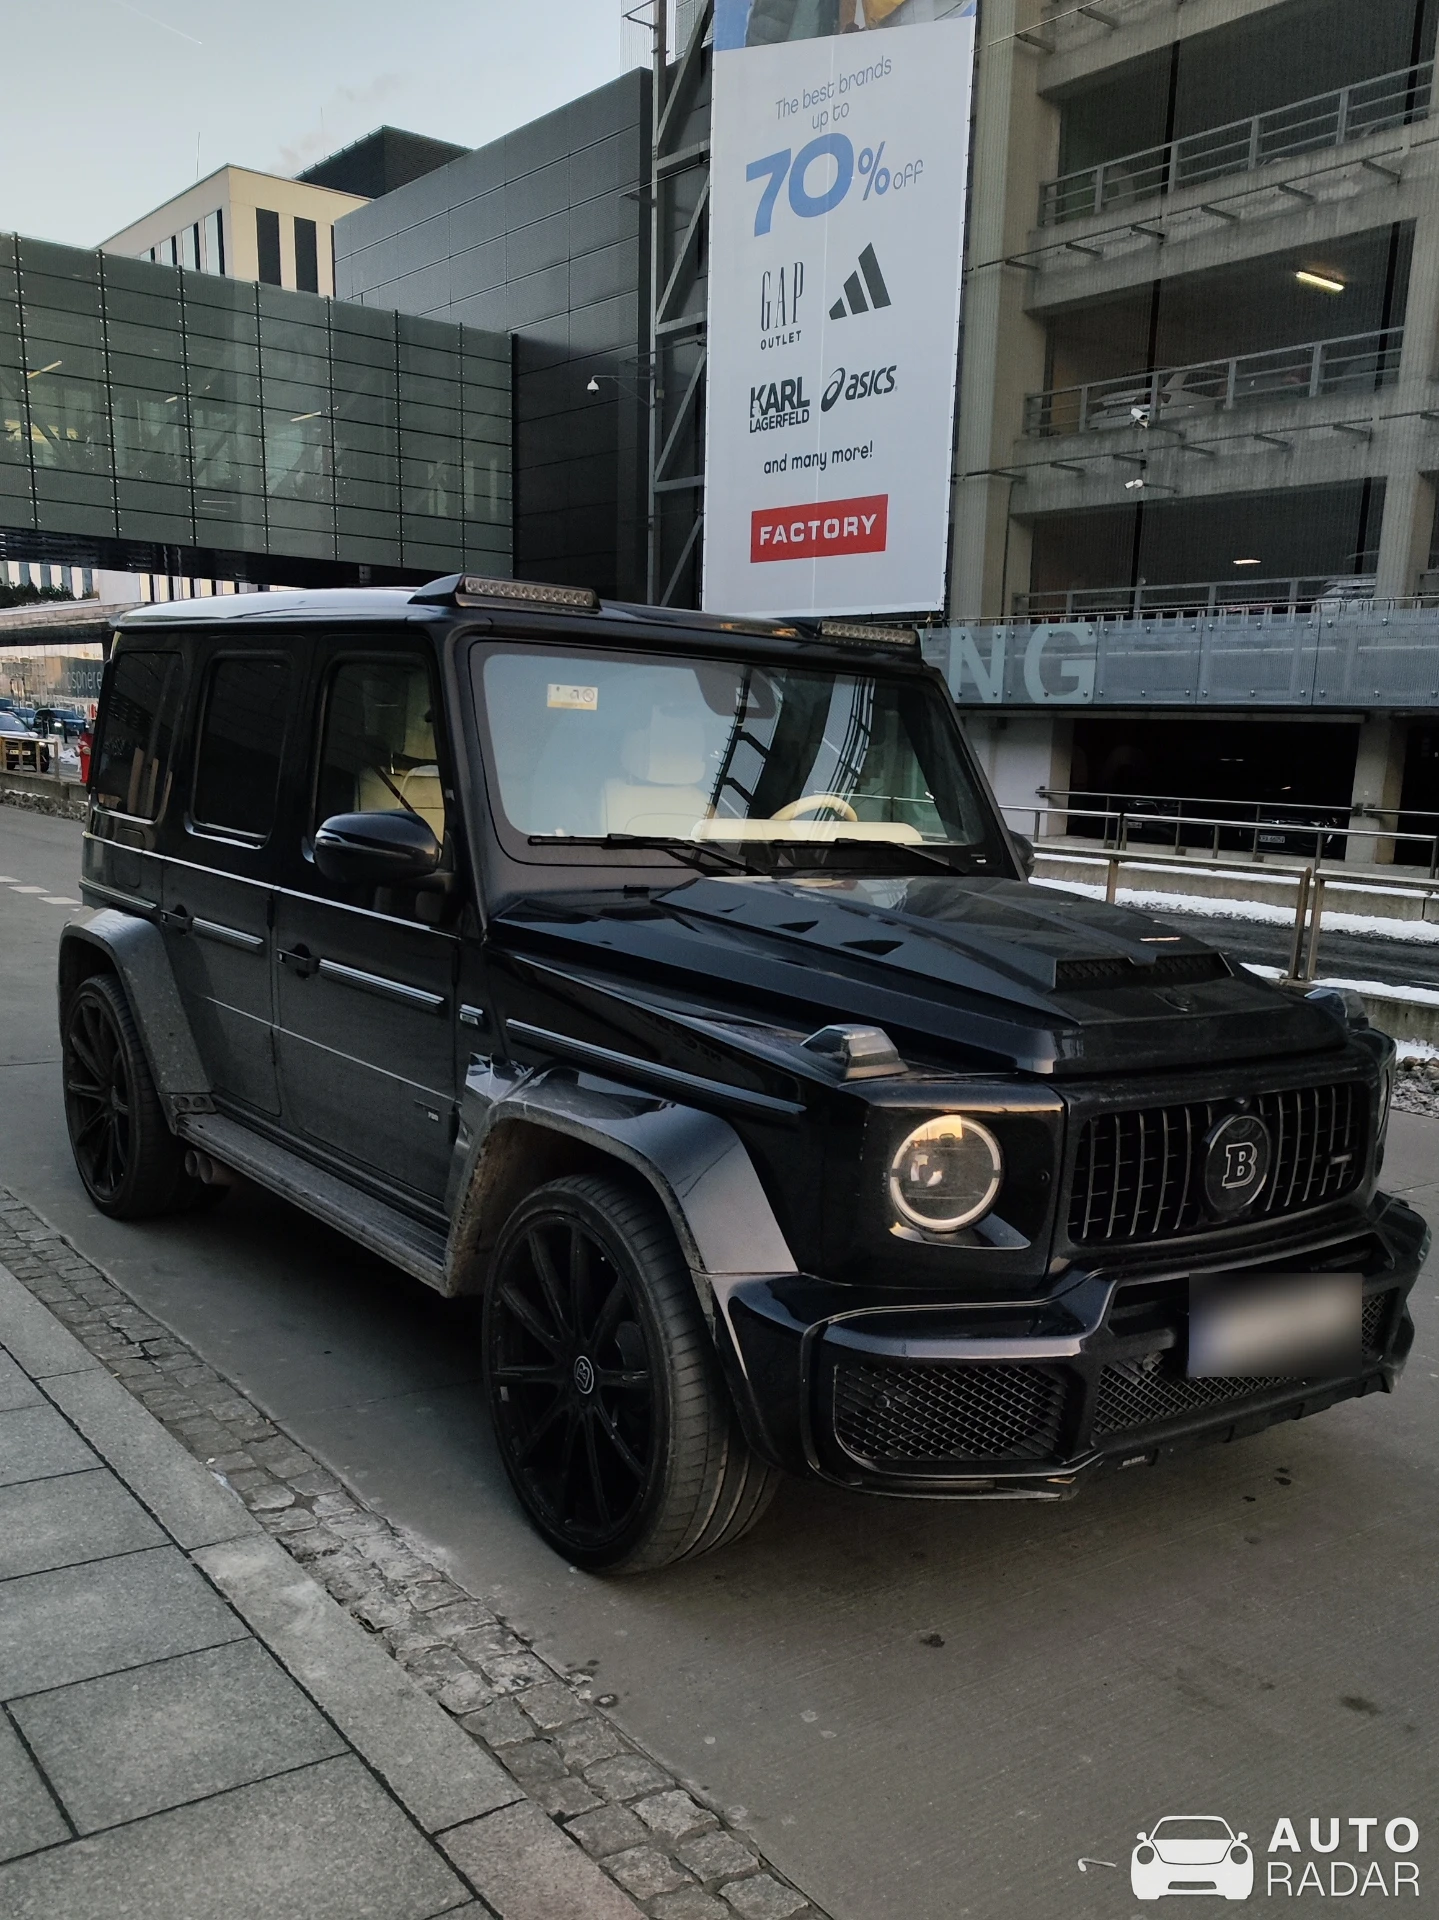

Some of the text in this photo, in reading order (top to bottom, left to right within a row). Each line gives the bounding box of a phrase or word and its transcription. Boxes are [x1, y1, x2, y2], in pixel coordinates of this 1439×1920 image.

[776, 56, 892, 120] The best brands
[811, 102, 850, 132] up to
[746, 133, 924, 237] 70% off
[760, 261, 804, 332] GAP
[760, 330, 802, 350] OUTLET
[750, 376, 810, 418] KARL
[750, 408, 810, 433] LAGERFELD
[764, 440, 873, 474] and many more!
[759, 514, 877, 545] FACTORY
[918, 623, 1097, 704] NG
[1222, 1142, 1258, 1189] B
